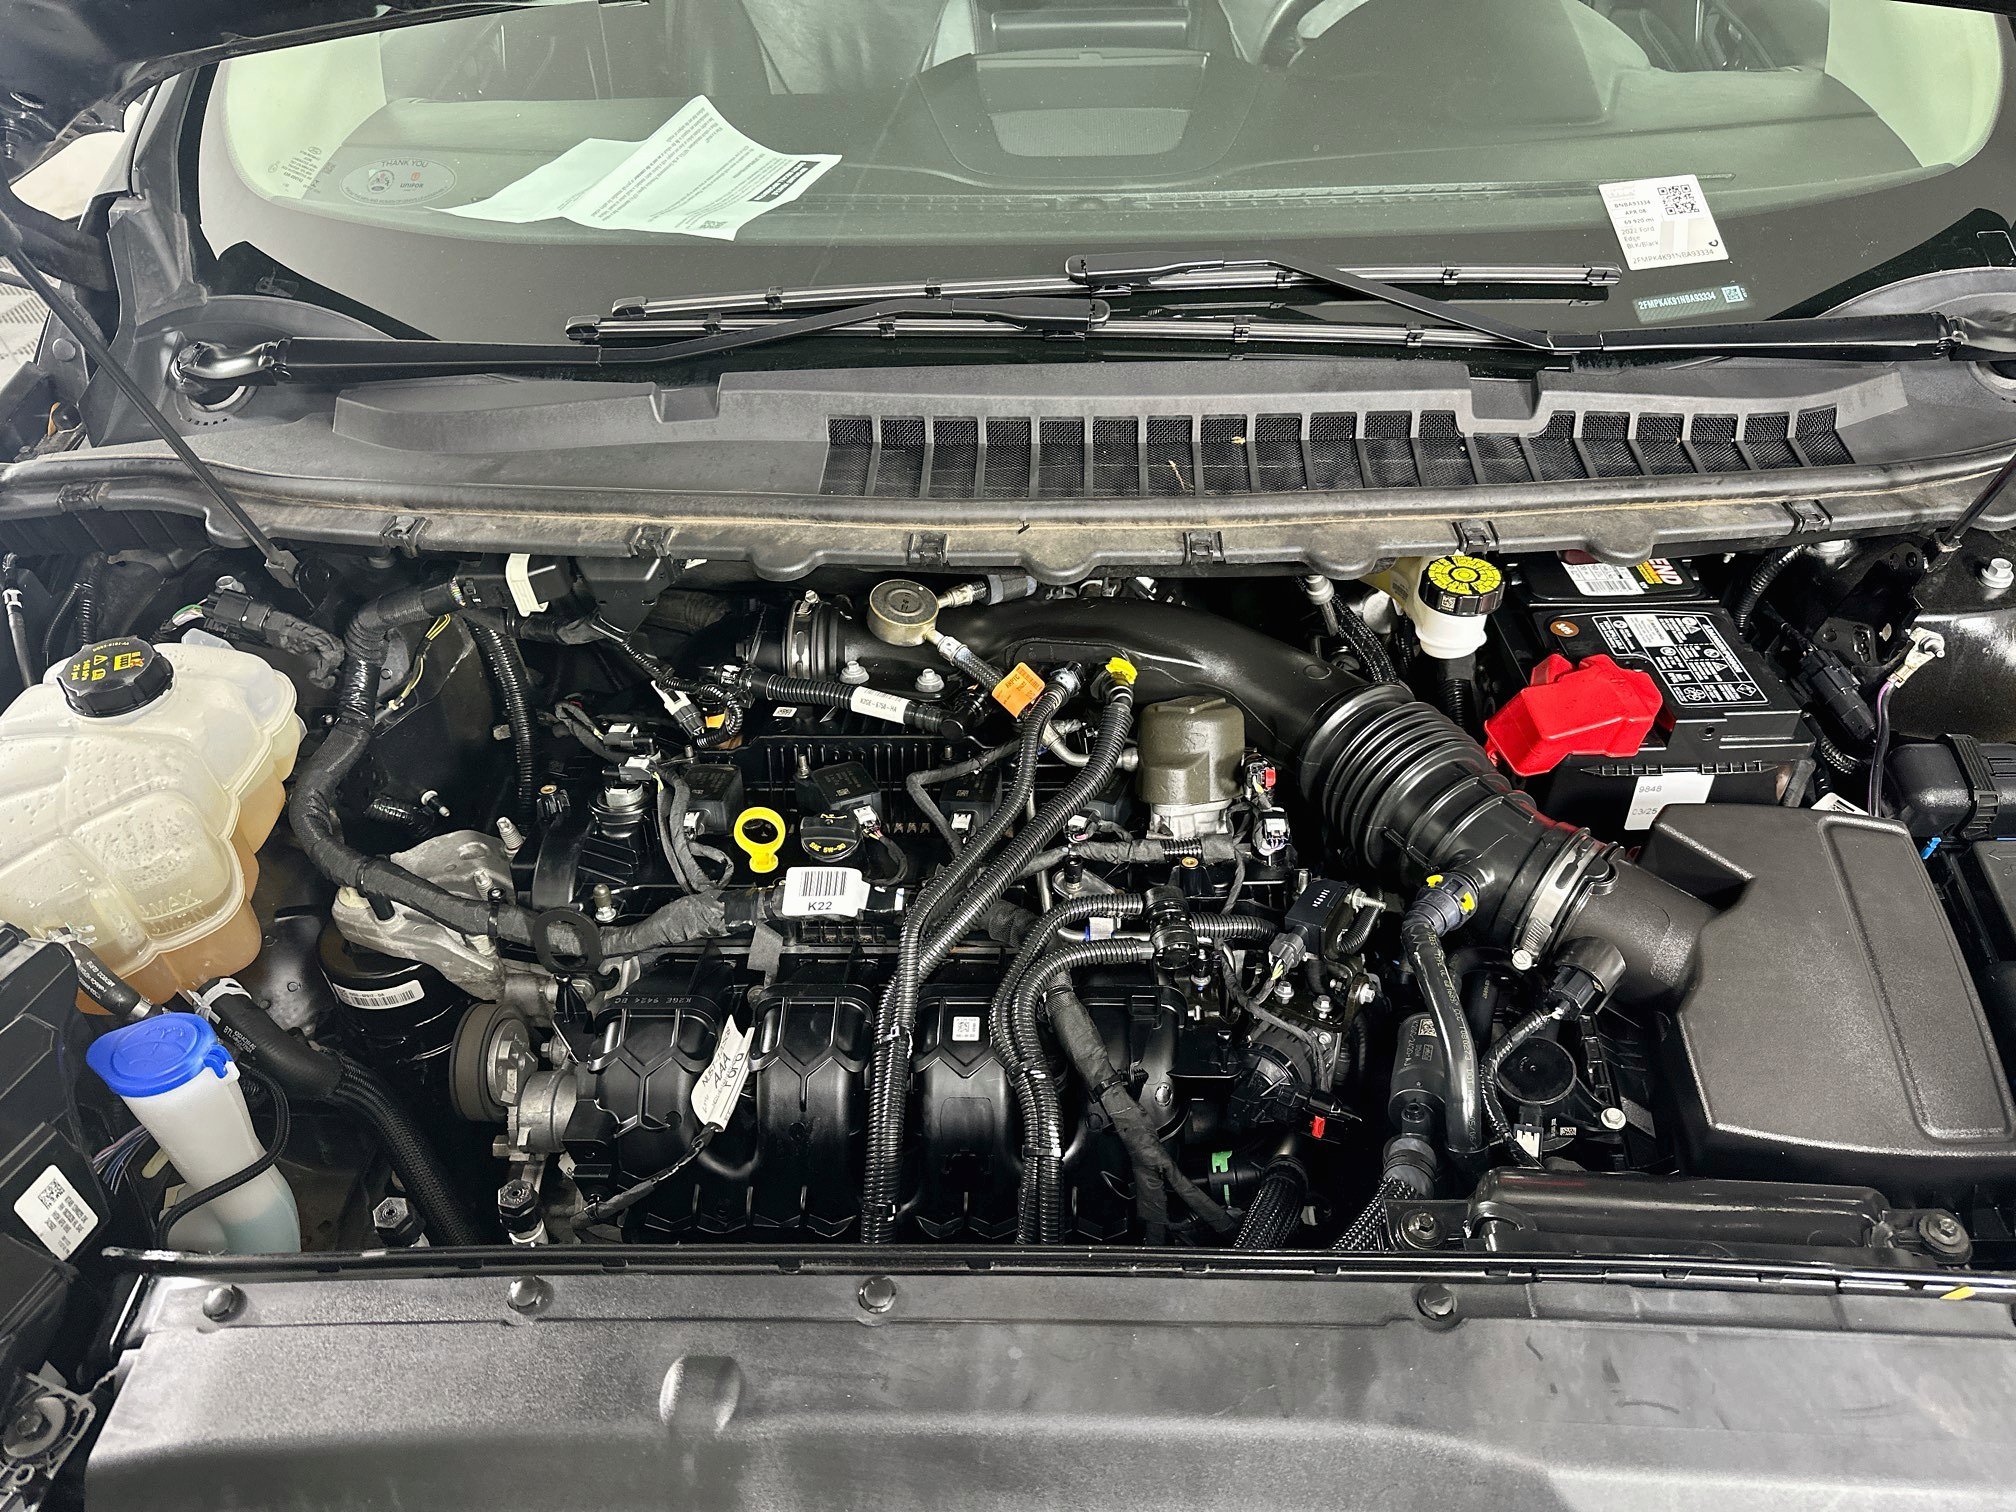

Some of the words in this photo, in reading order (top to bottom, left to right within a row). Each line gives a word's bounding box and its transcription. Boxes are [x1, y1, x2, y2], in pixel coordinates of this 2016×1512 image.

[412, 160, 429, 168] YOU
[1625, 208, 1637, 216] APR
[1638, 291, 1716, 310] 2FMPK4K91NBA93334
[1639, 785, 1663, 793] 9848
[1631, 807, 1659, 816] 03/25
[809, 842, 822, 852] SAE
[823, 842, 847, 853] 5W-30
[808, 901, 833, 911] K22
[713, 1052, 731, 1089] AAA
